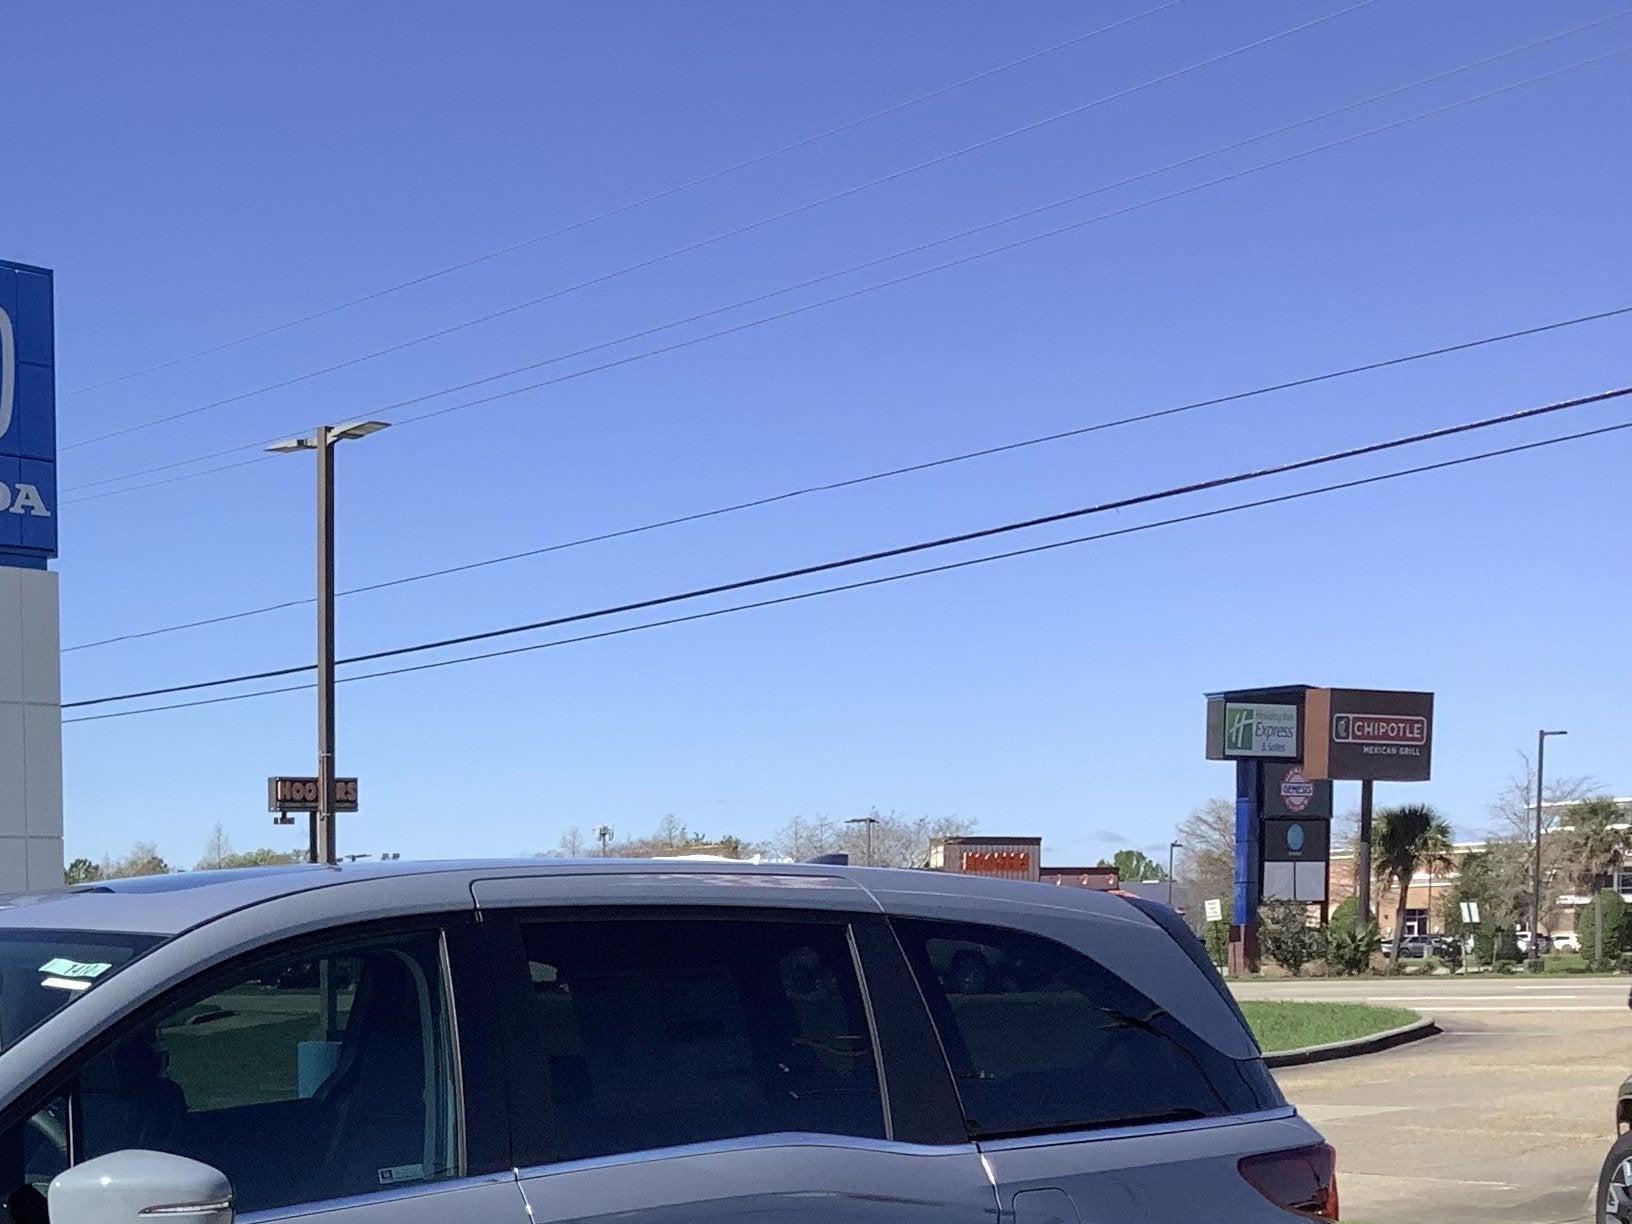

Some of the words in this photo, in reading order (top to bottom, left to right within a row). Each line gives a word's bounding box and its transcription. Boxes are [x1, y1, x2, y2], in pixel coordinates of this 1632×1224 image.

[1255, 721, 1294, 741] Express
[1355, 721, 1422, 738] CHIPOTLE
[1363, 746, 1397, 755] MEXICAN
[1399, 747, 1421, 756] GRILL
[277, 780, 357, 801] HOORS
